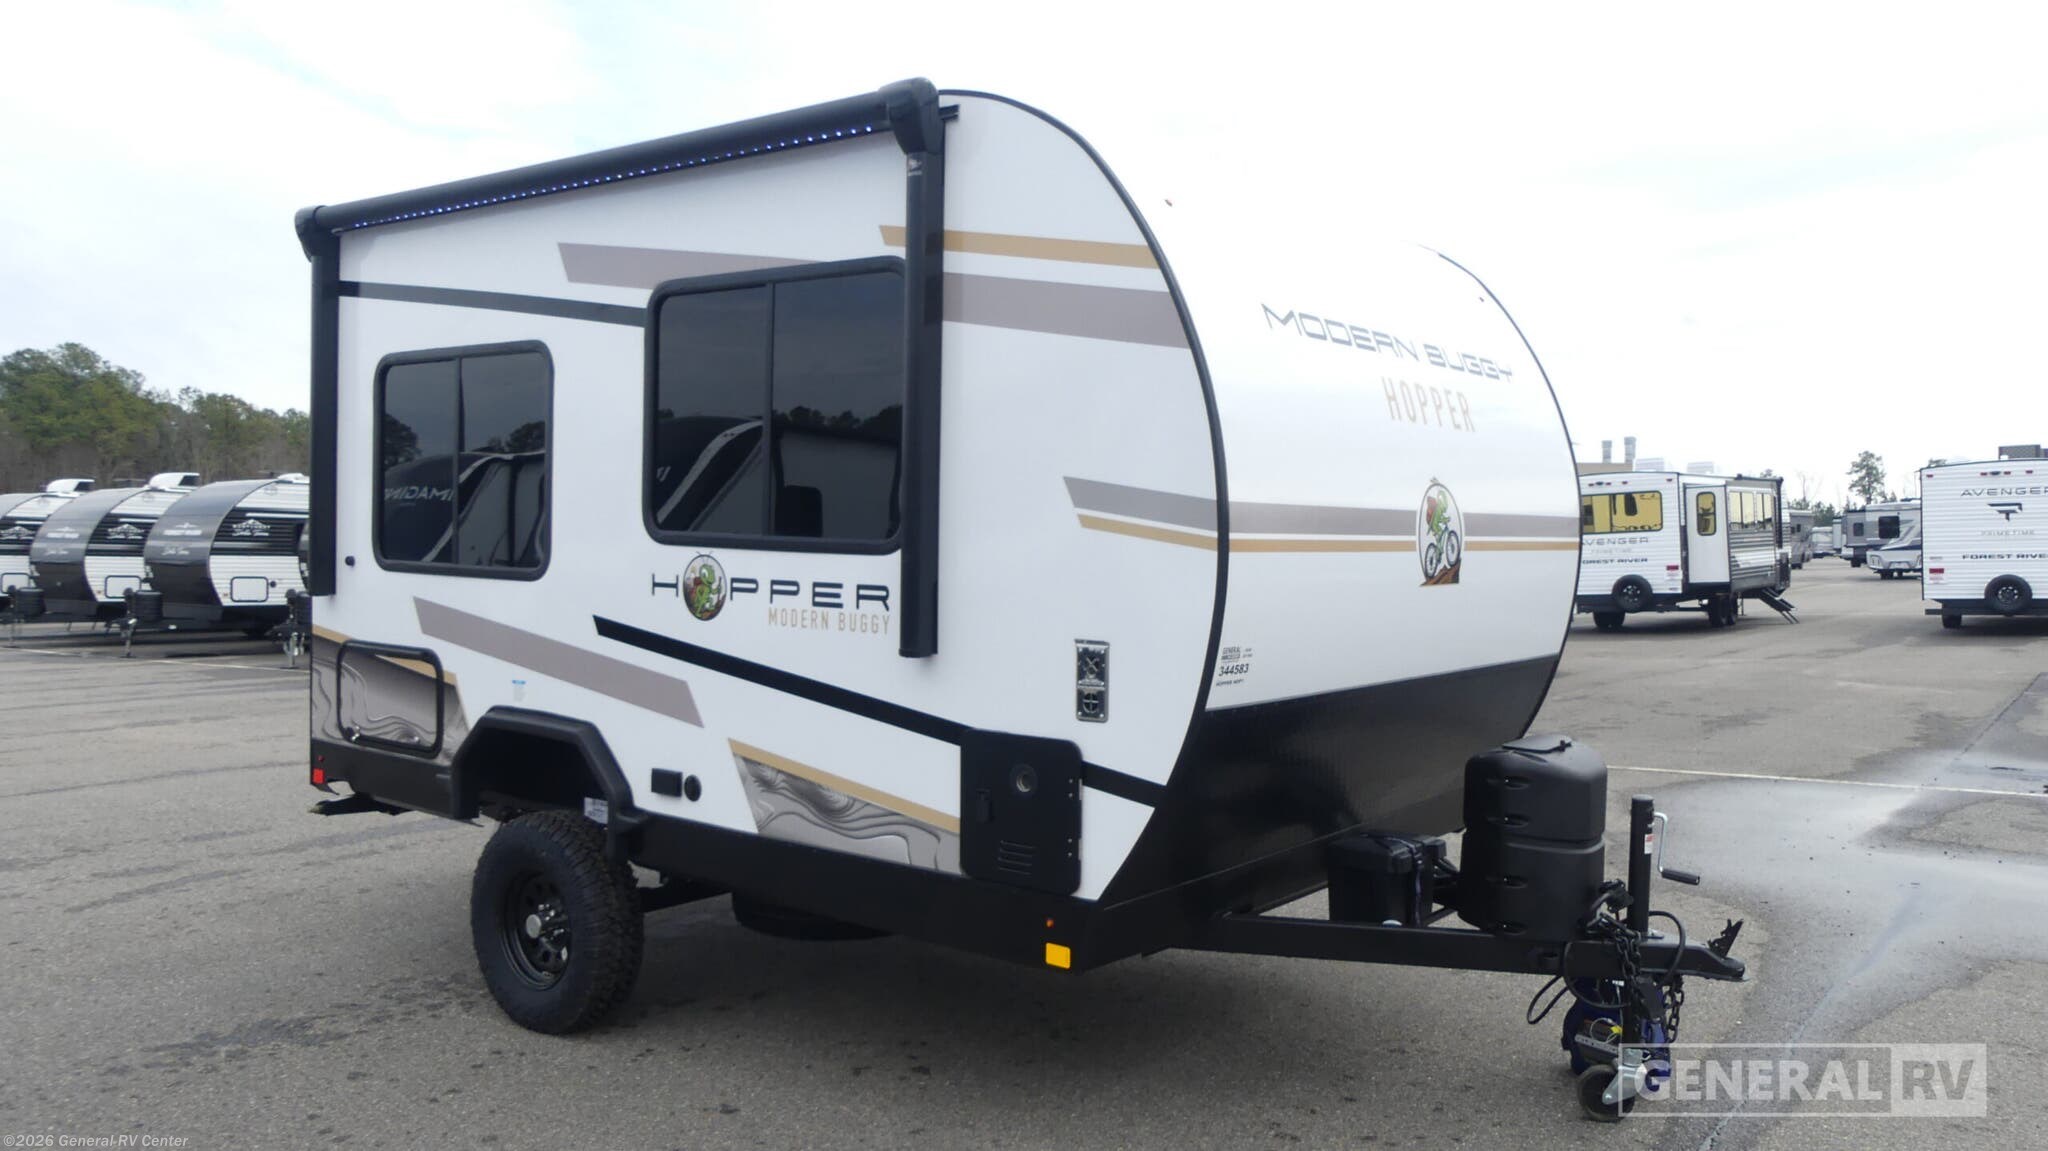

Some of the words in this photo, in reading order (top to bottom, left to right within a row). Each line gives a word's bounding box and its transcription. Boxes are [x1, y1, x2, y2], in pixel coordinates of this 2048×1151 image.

[1261, 303, 1420, 362] MODERN
[1423, 343, 1513, 383] BUGGY
[1382, 376, 1475, 432] HOPPER
[651, 561, 891, 617] HOPPER
[768, 607, 830, 631] MODERN
[838, 612, 890, 635] BUGGY
[1218, 663, 1249, 676] 344583
